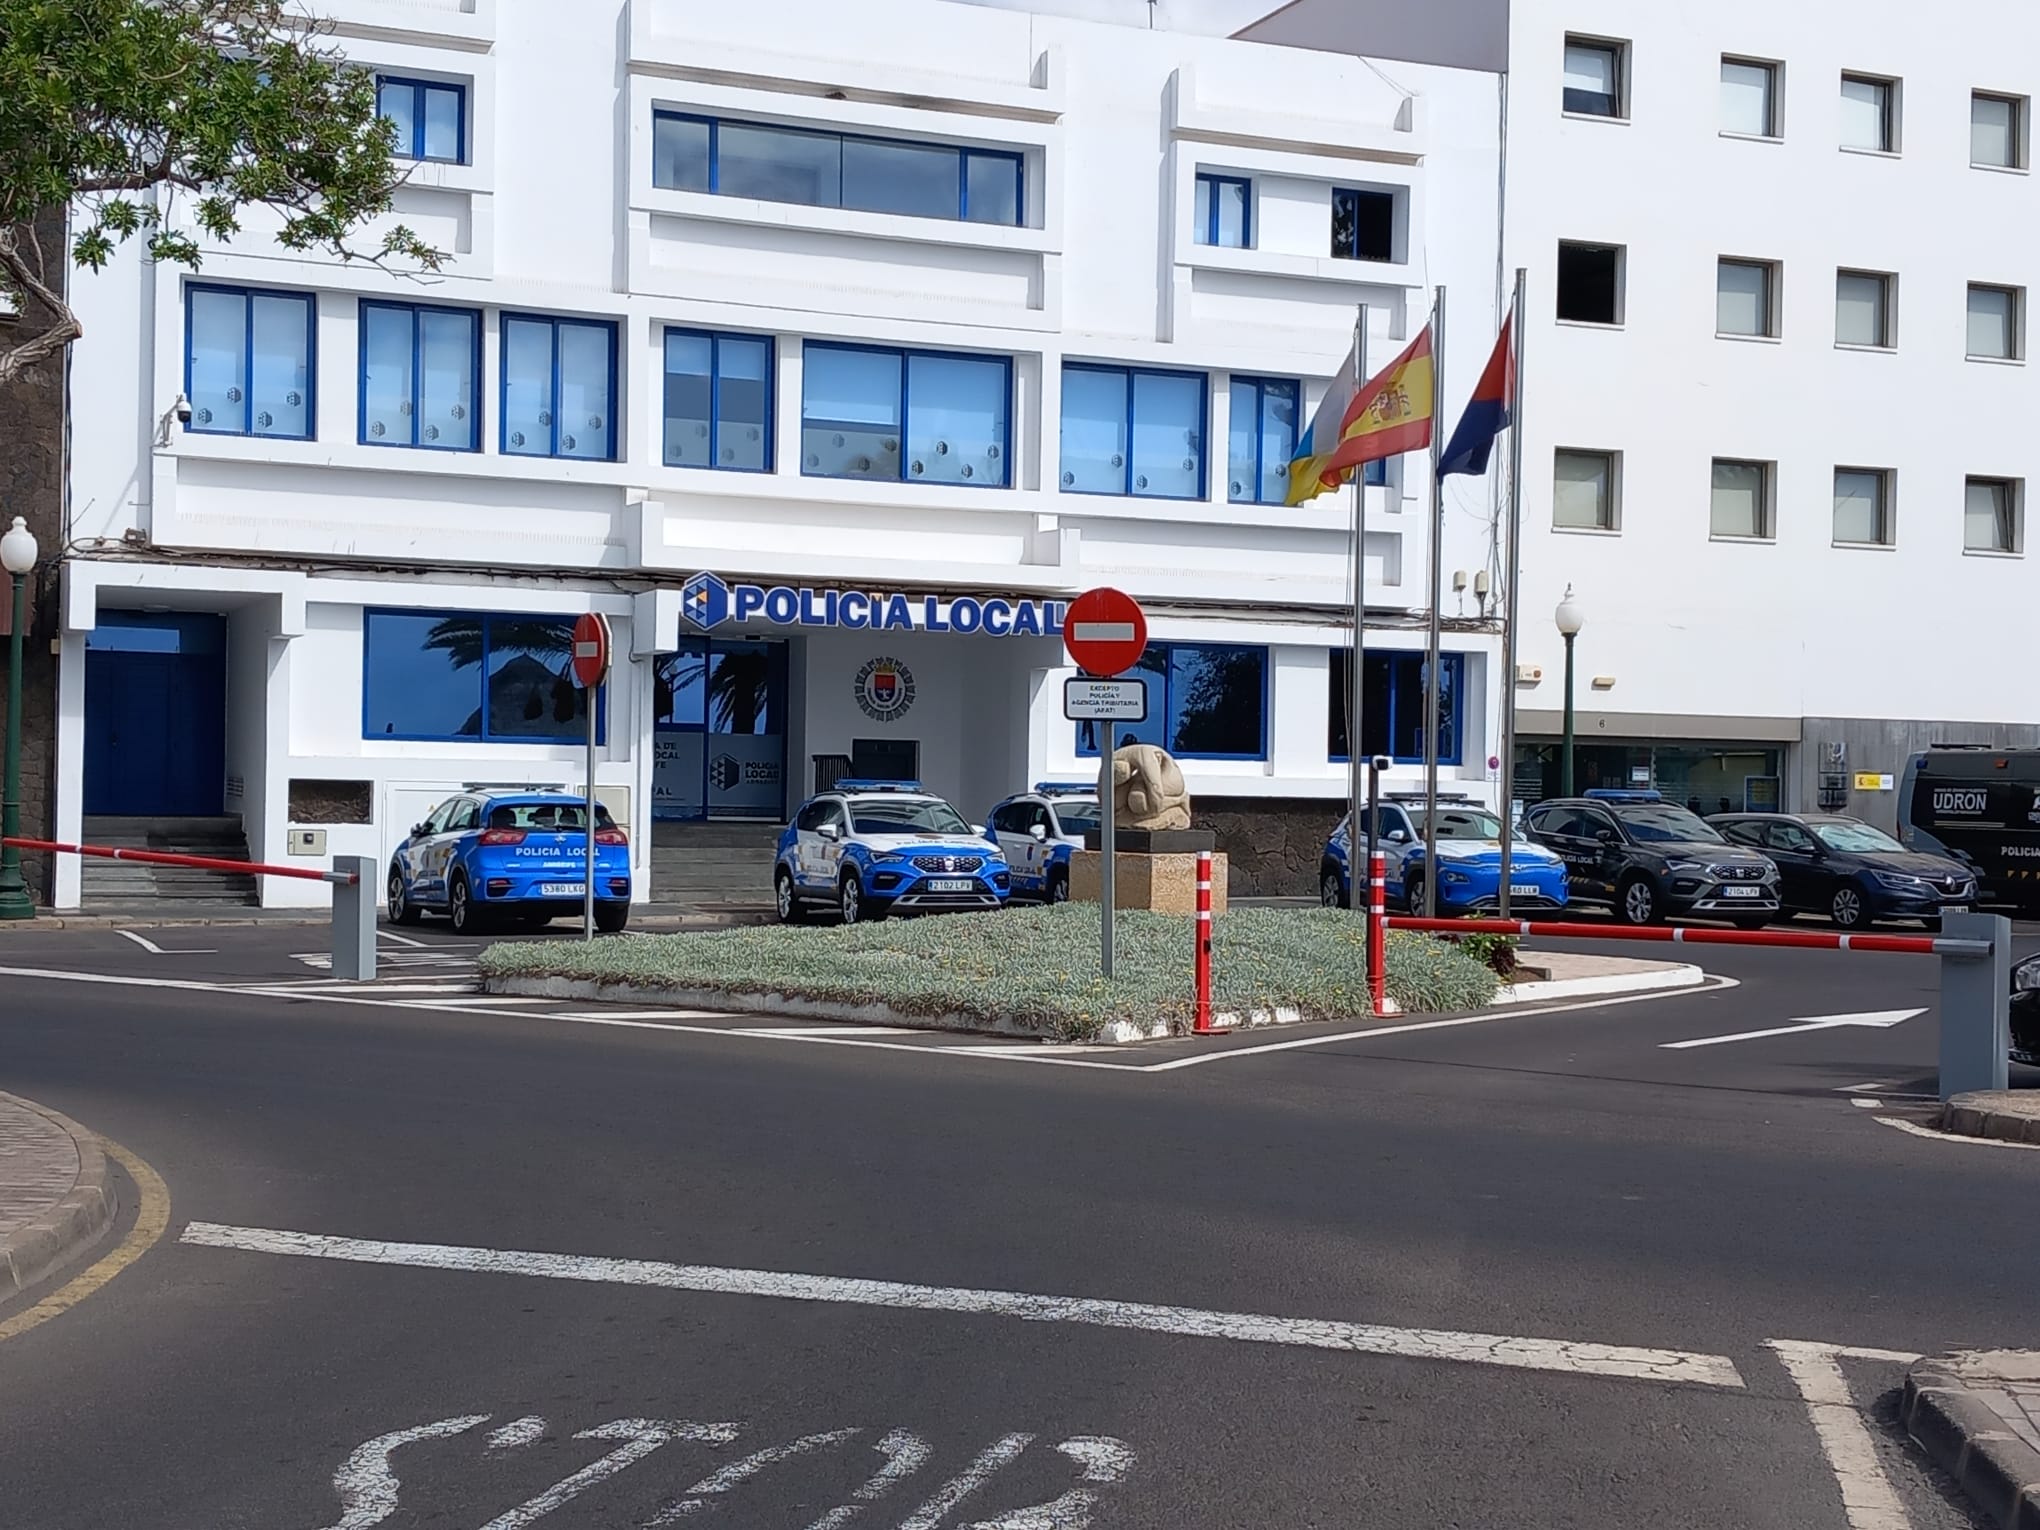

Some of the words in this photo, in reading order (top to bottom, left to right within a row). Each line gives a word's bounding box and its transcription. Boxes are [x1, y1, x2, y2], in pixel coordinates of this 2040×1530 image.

[924, 595, 1065, 637] LOCAL
[1599, 719, 1605, 729] 6
[663, 742, 677, 750] DE
[1933, 793, 1987, 810] UDRON
[515, 847, 561, 857] POLICIA
[566, 847, 600, 857] LOCL
[933, 880, 954, 889] 2102
